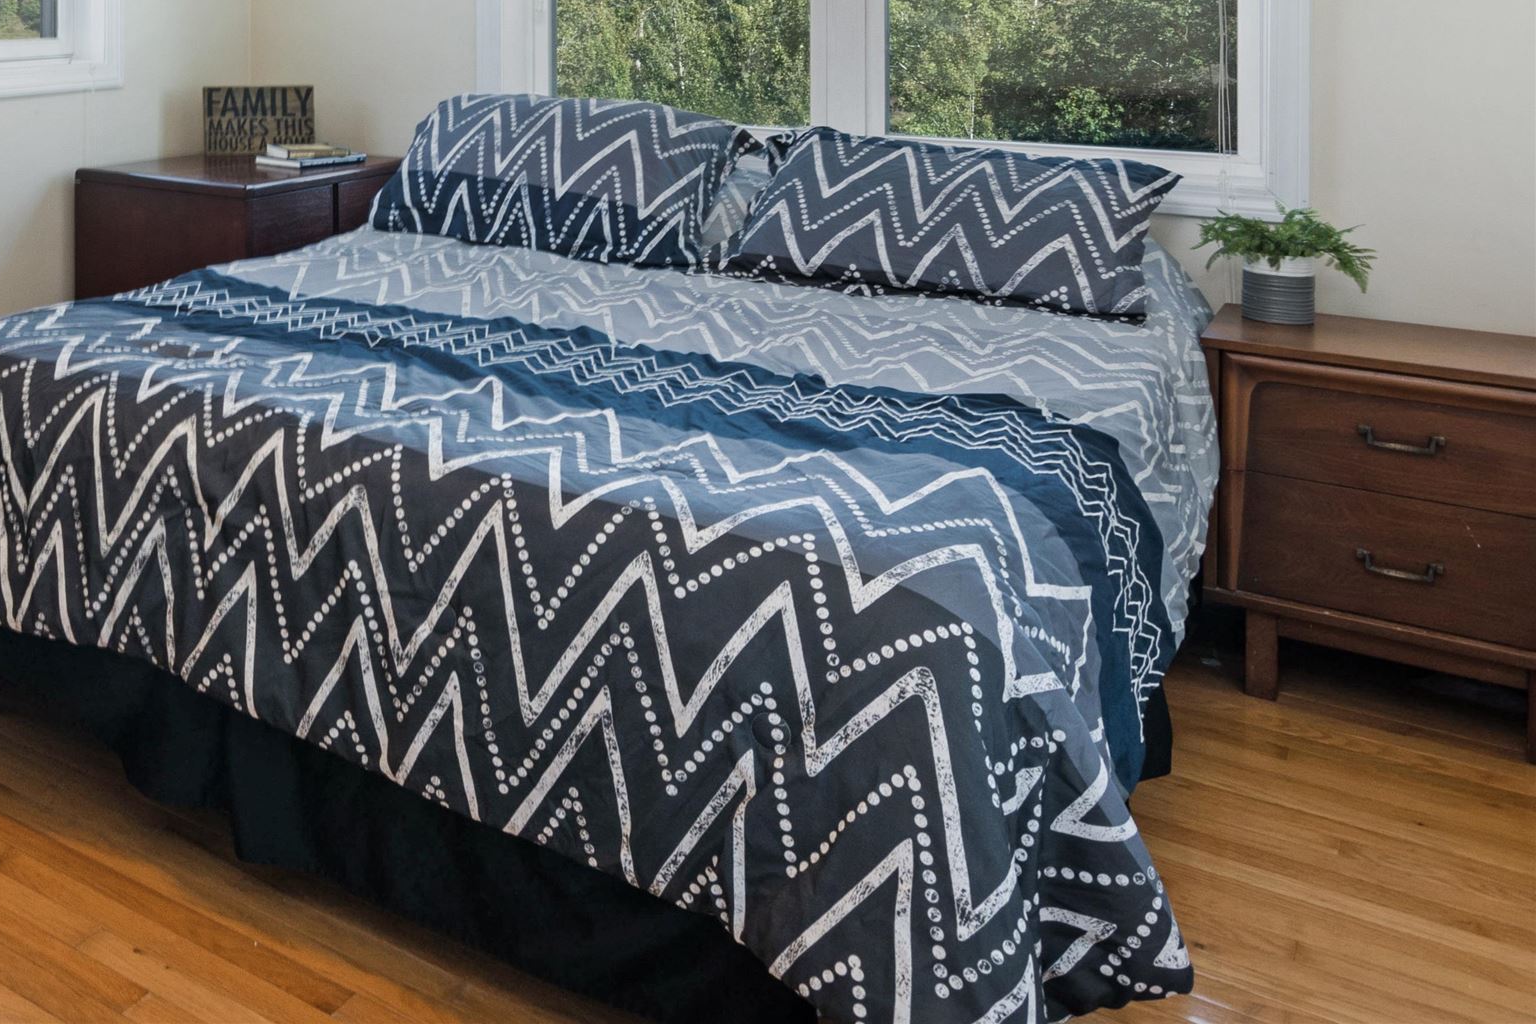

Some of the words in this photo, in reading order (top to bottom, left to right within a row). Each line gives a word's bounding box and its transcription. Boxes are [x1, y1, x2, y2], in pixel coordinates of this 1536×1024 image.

[206, 87, 313, 117] FAMILY
[208, 118, 269, 136] MAKES
[274, 118, 315, 136] THIS
[208, 136, 253, 152] HOUSE
